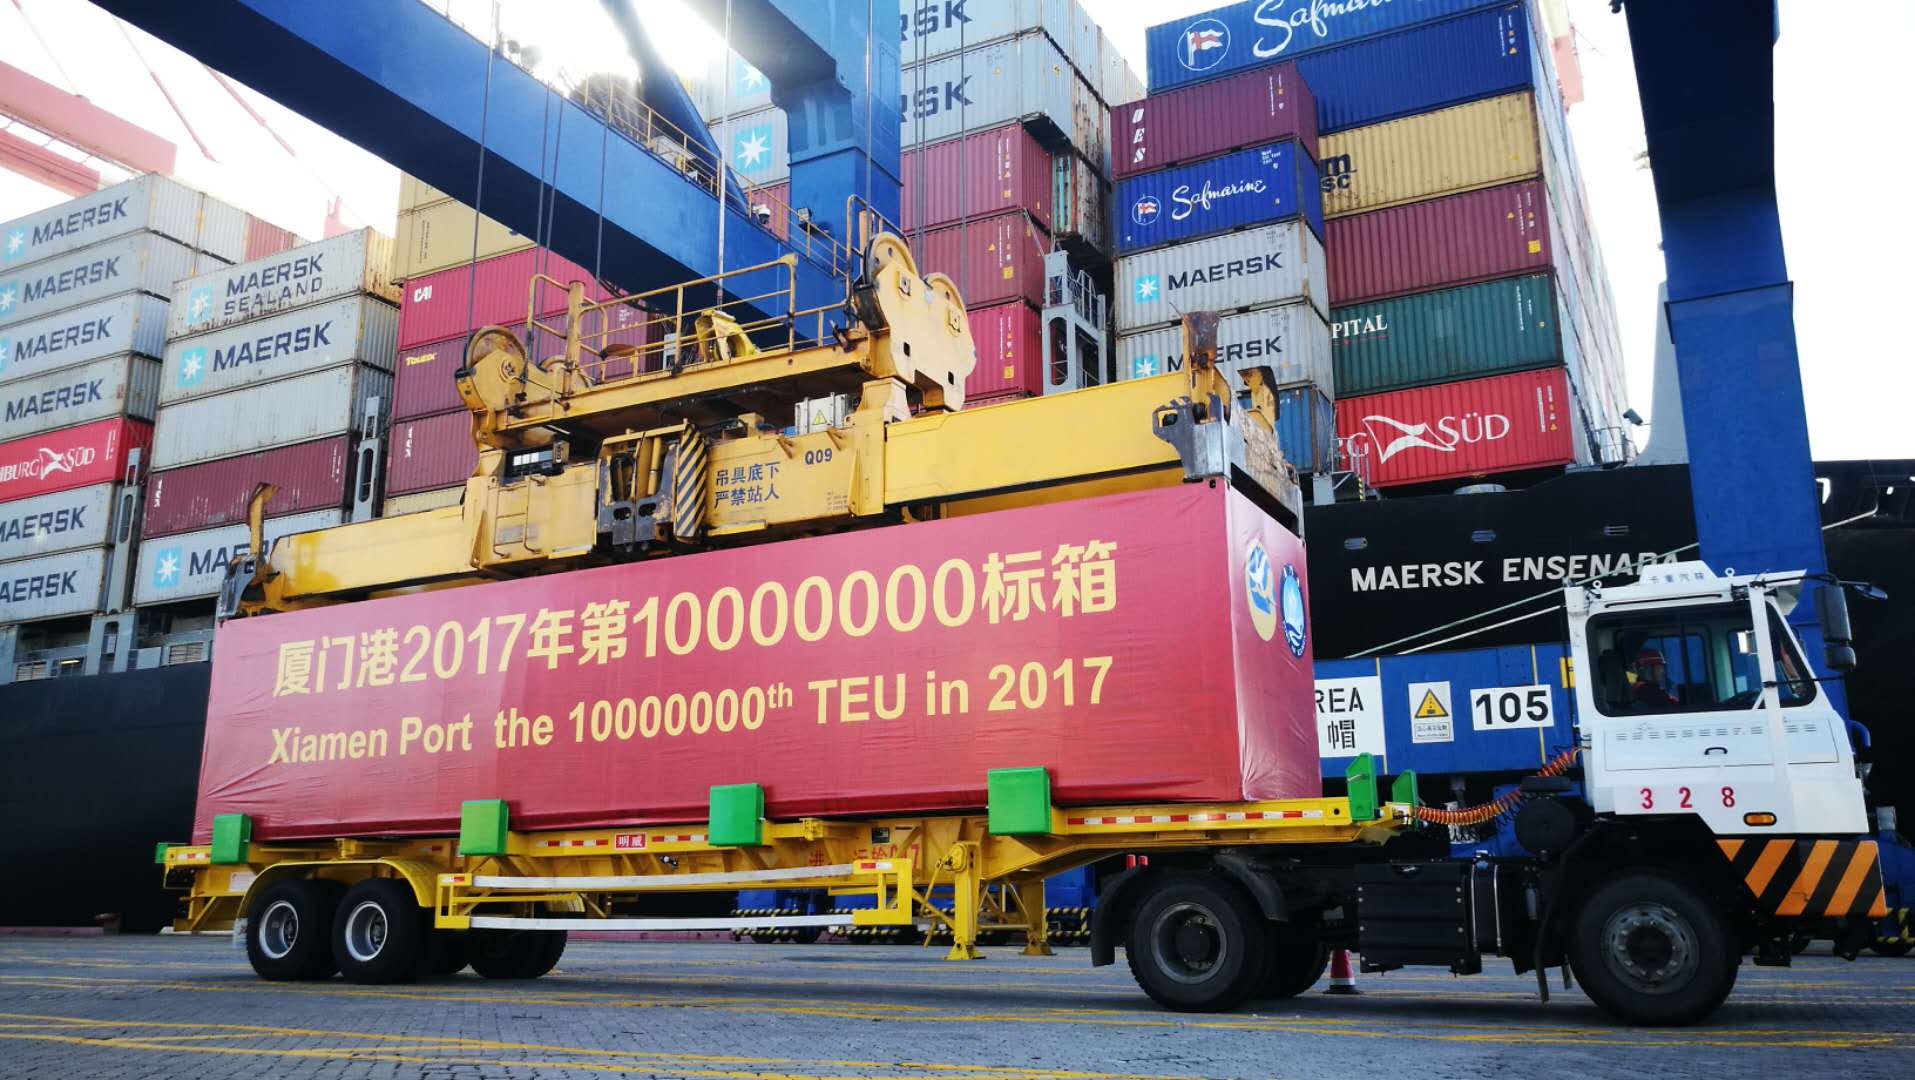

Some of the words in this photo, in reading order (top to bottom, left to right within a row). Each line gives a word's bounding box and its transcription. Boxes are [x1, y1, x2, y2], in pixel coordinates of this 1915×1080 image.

[1172, 180, 1266, 220] Safmarine
[32, 196, 128, 246] MAERSK
[24, 256, 120, 303] MAERSK
[227, 253, 323, 297] MAERSK
[1168, 252, 1283, 290] MAERSK
[224, 277, 322, 315] SEALAND
[414, 285, 432, 302] CAI
[15, 316, 112, 362] MAERSK
[1332, 315, 1387, 338] PITAL
[213, 320, 332, 372] MAERSK
[1167, 336, 1282, 372] MERSK
[6, 378, 103, 422] MAERSK
[1438, 411, 1510, 448] SÜD
[0, 458, 39, 481] BURG
[716, 461, 780, 486] 吊具底下
[804, 448, 833, 465] Q09
[714, 484, 780, 509] 严禁站人
[1351, 560, 1484, 592] MAERSK
[273, 540, 1117, 697] 厦门港2017年第10000000标箱
[268, 727, 387, 764] Xiamen
[400, 713, 473, 755] Port
[494, 707, 553, 749] the
[568, 682, 793, 743] 10000000th
[808, 673, 906, 724] TEU
[926, 670, 969, 715] in
[987, 656, 1113, 711] 2017
[1476, 690, 1549, 726] 105
[1328, 719, 1355, 749] 帽
